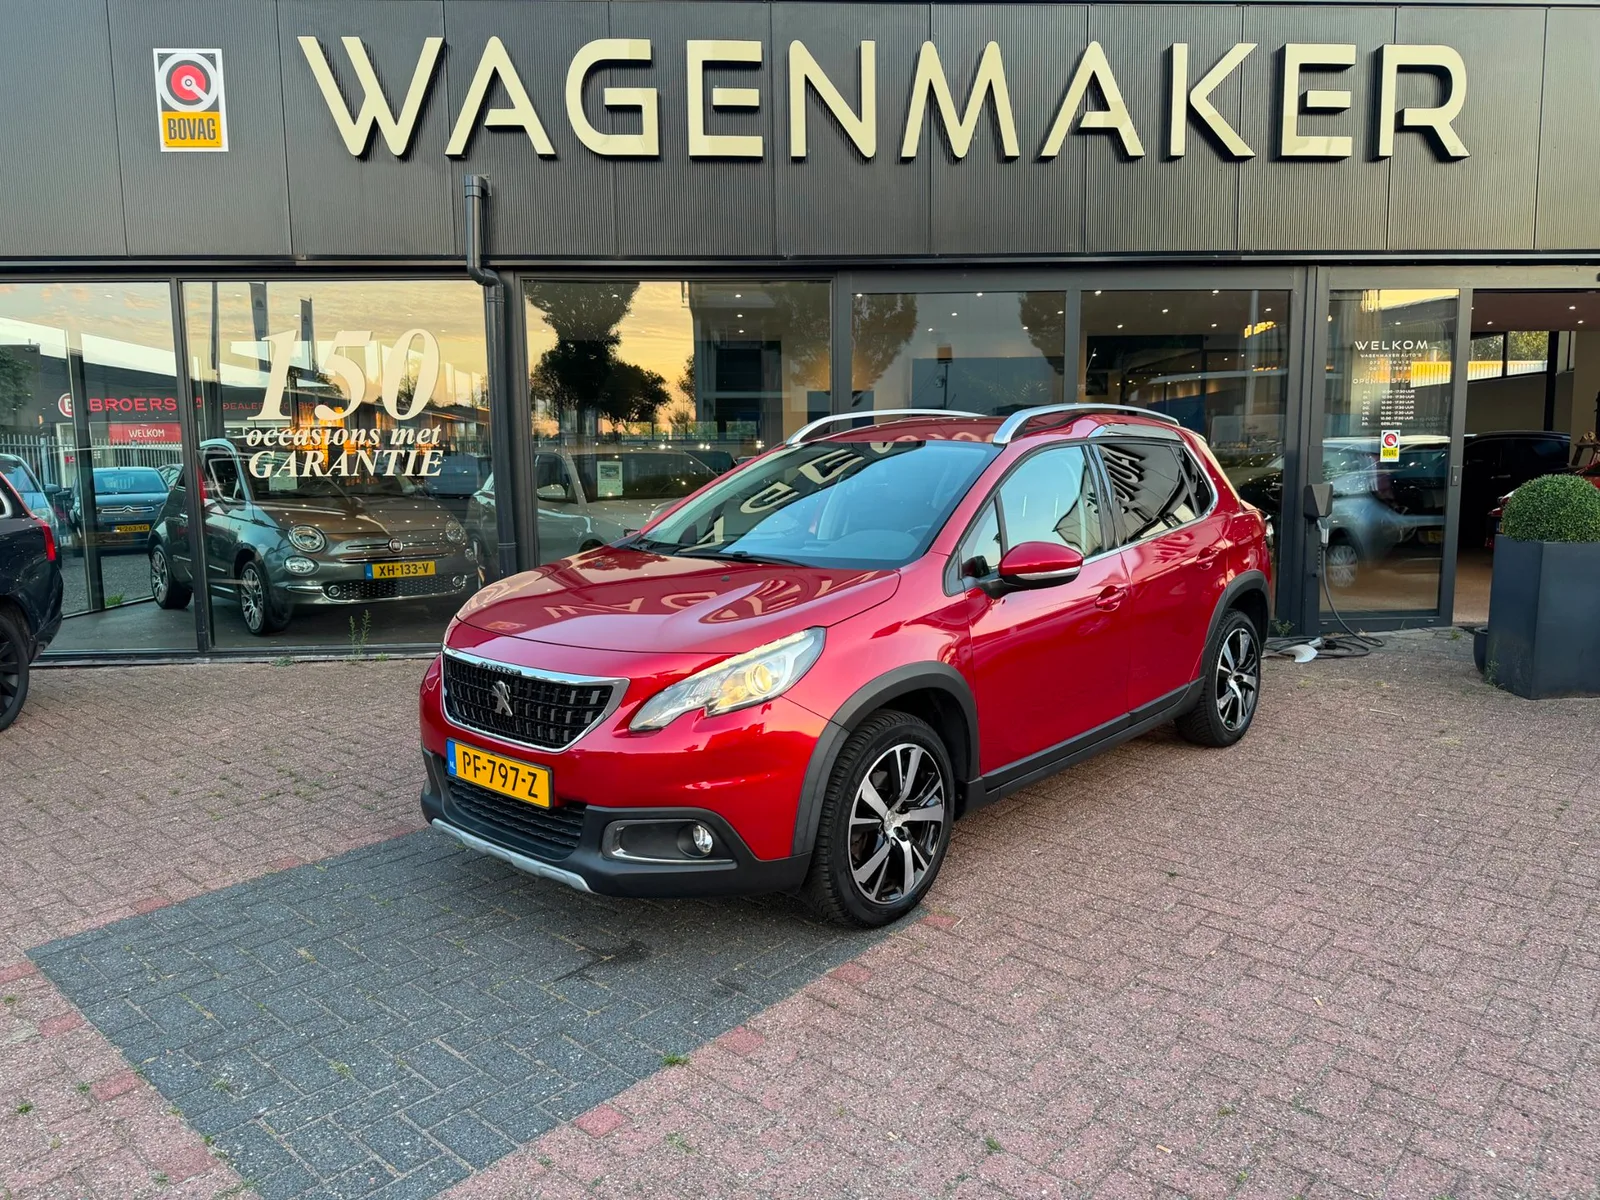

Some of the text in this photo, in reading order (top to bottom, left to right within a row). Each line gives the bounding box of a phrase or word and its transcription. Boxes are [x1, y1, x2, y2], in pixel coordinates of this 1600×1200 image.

[297, 36, 1471, 159] WAGENMAKER
[167, 117, 216, 140] BOVAG
[1354, 340, 1428, 350] WELKOM
[247, 328, 441, 420] 150
[128, 429, 165, 438] WELKOM
[246, 424, 442, 447] occasions met
[248, 449, 444, 478] GARANTIE
[378, 562, 430, 577] XH-133-V
[449, 761, 456, 770] NL
[462, 750, 538, 799] PF-797-Z
